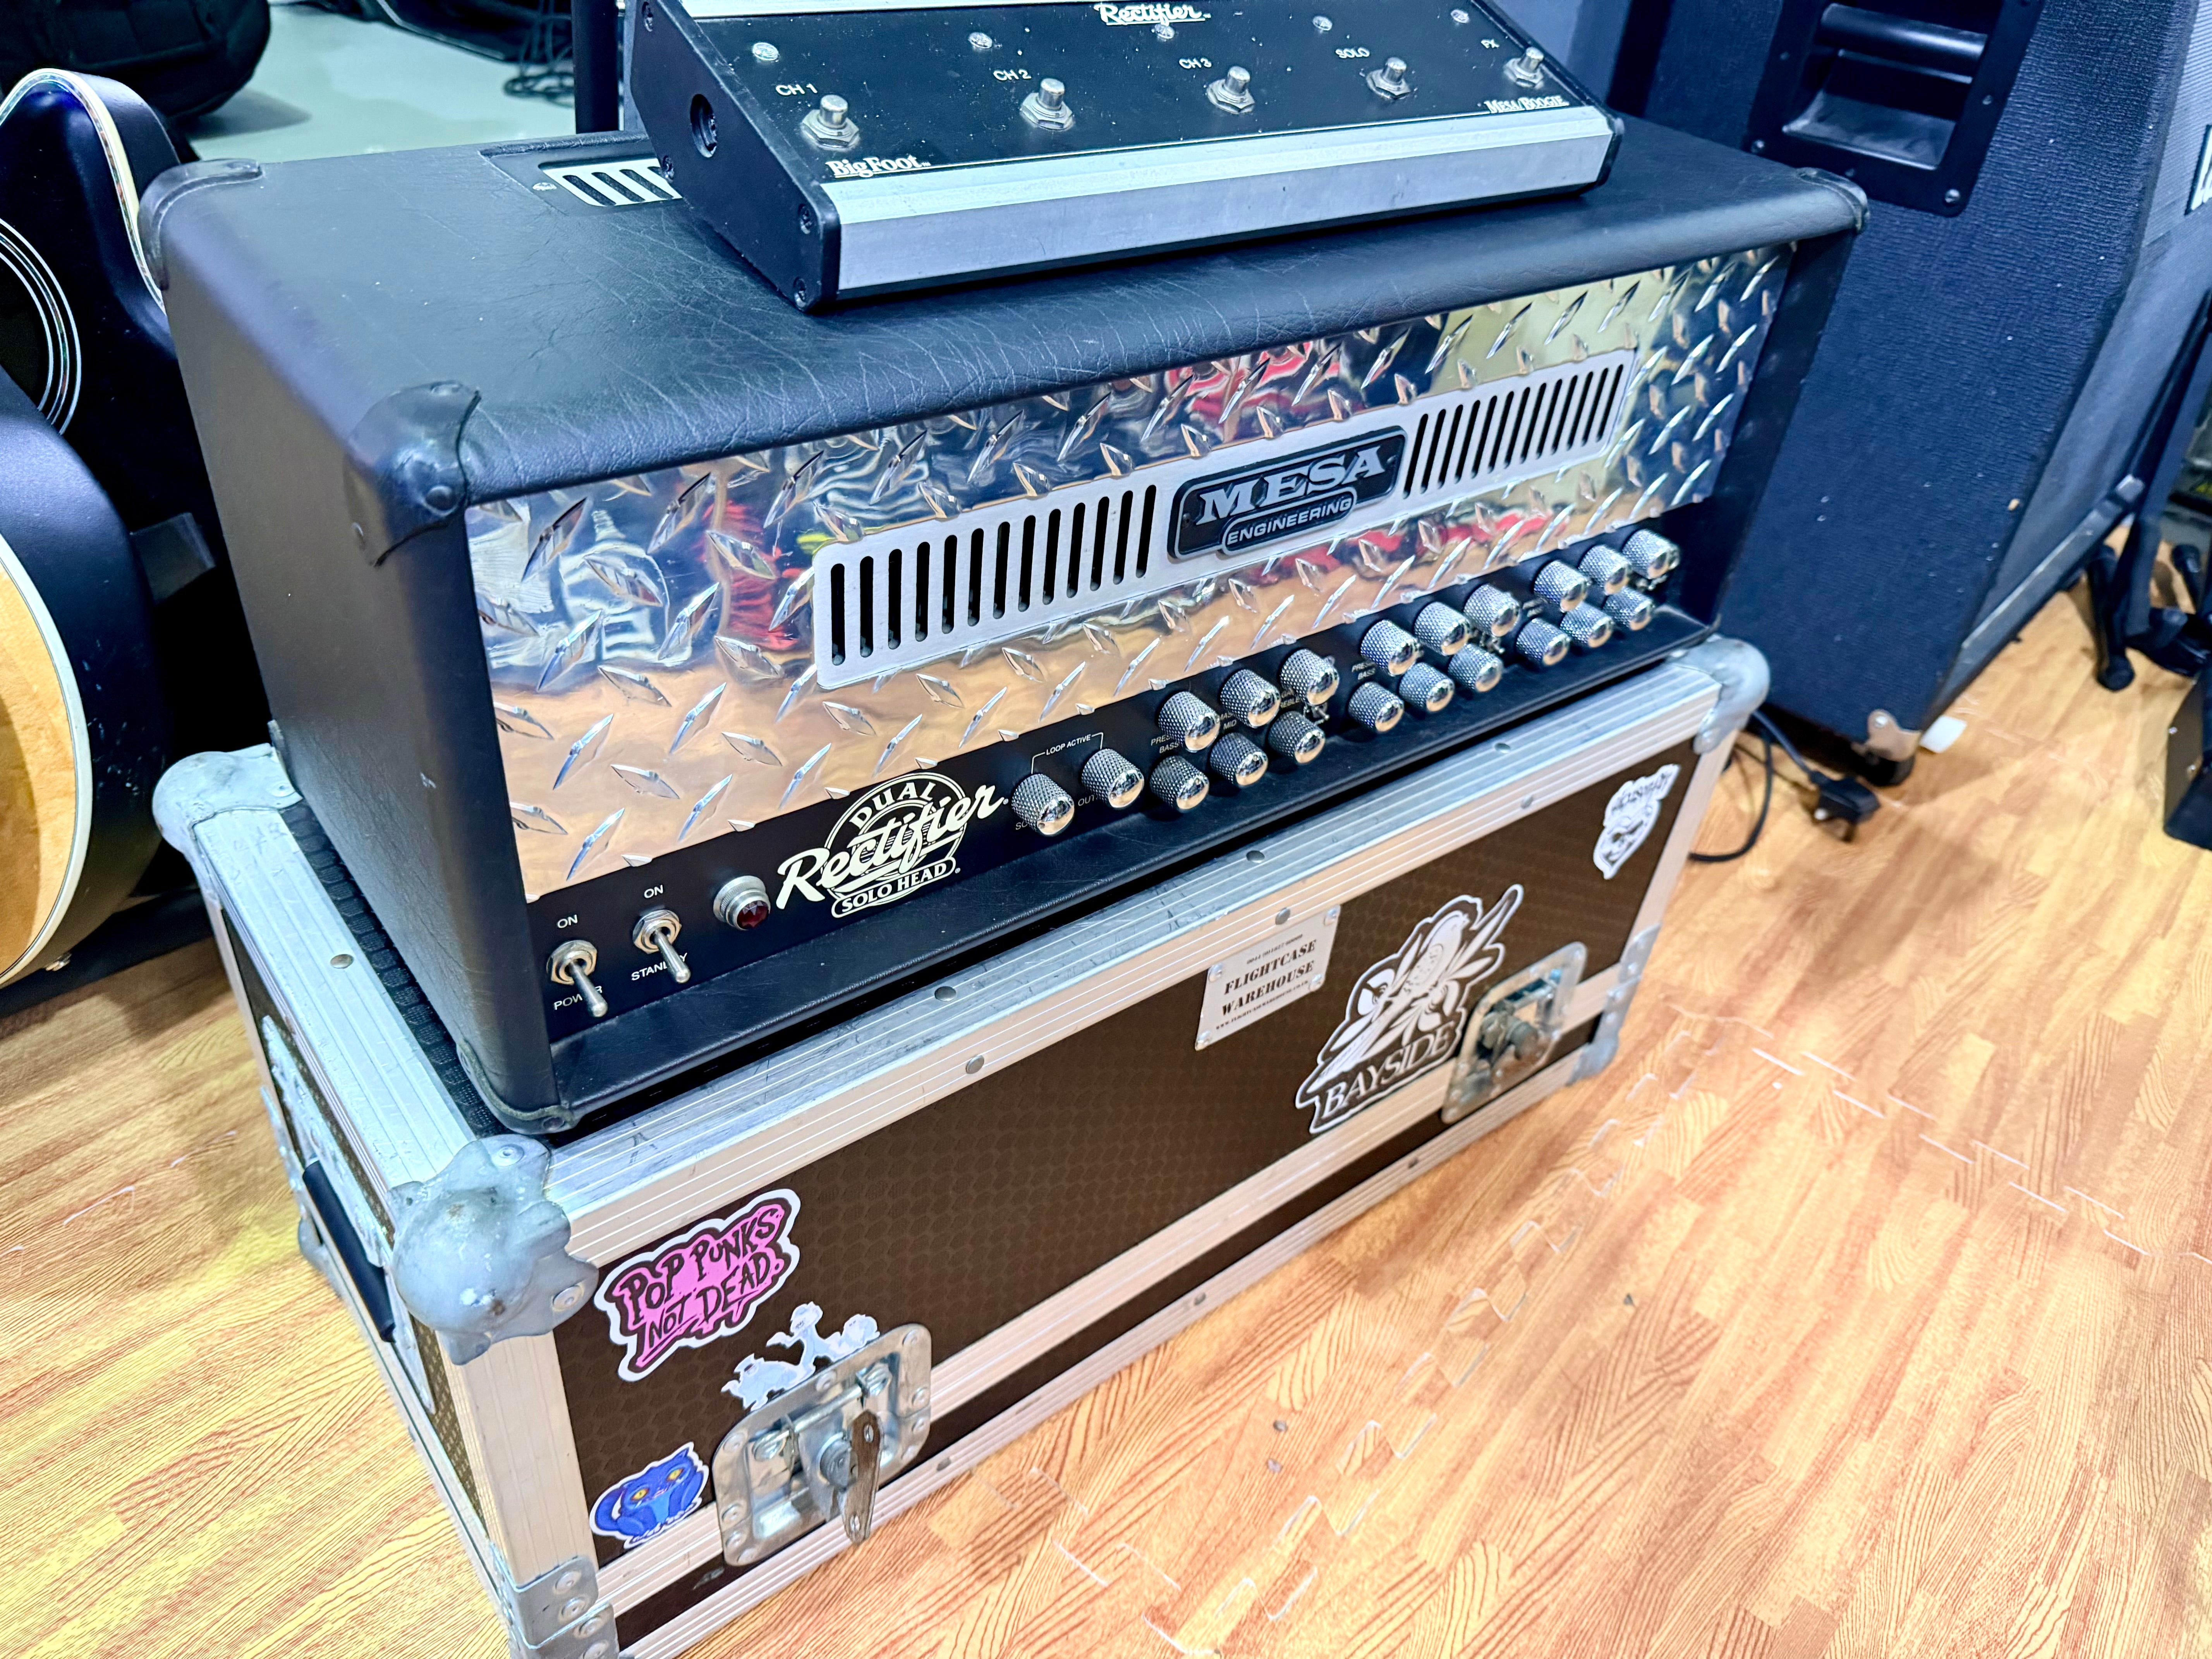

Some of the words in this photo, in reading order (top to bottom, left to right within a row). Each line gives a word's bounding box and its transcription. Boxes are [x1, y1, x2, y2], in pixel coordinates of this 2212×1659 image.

[1094, 3, 1202, 26] Rectifier
[1335, 47, 1370, 58] SOLO
[1481, 39, 1500, 48] FX
[993, 70, 1019, 81] CH
[1018, 69, 1032, 79] 2
[1179, 58, 1202, 69] CH
[1200, 58, 1212, 67] 3
[775, 84, 805, 95] CH
[806, 83, 817, 93] 1
[1196, 445, 1385, 525] MESA
[1227, 497, 1352, 544] ENGINEERING
[1223, 720, 1237, 730] MID
[1046, 743, 1065, 755] LOOP
[1066, 734, 1091, 748] ACTIVE
[1159, 742, 1179, 754] BASS
[850, 782, 936, 829] DUAL
[776, 785, 1005, 910] Rectifier
[644, 884, 663, 898] ON
[841, 883, 892, 913] SOLO
[898, 863, 947, 892] HEAD
[557, 914, 578, 929] ON
[631, 952, 688, 981] STANY
[1224, 939, 1317, 995] FLIGHTCASE
[554, 986, 603, 1010] POWR
[1222, 960, 1315, 1016] WAREHOUSE
[1321, 1020, 1455, 1119] BAYSIDE
[619, 1253, 684, 1325] POP
[690, 1208, 778, 1281] PUNKS
[649, 1293, 692, 1348] NOT
